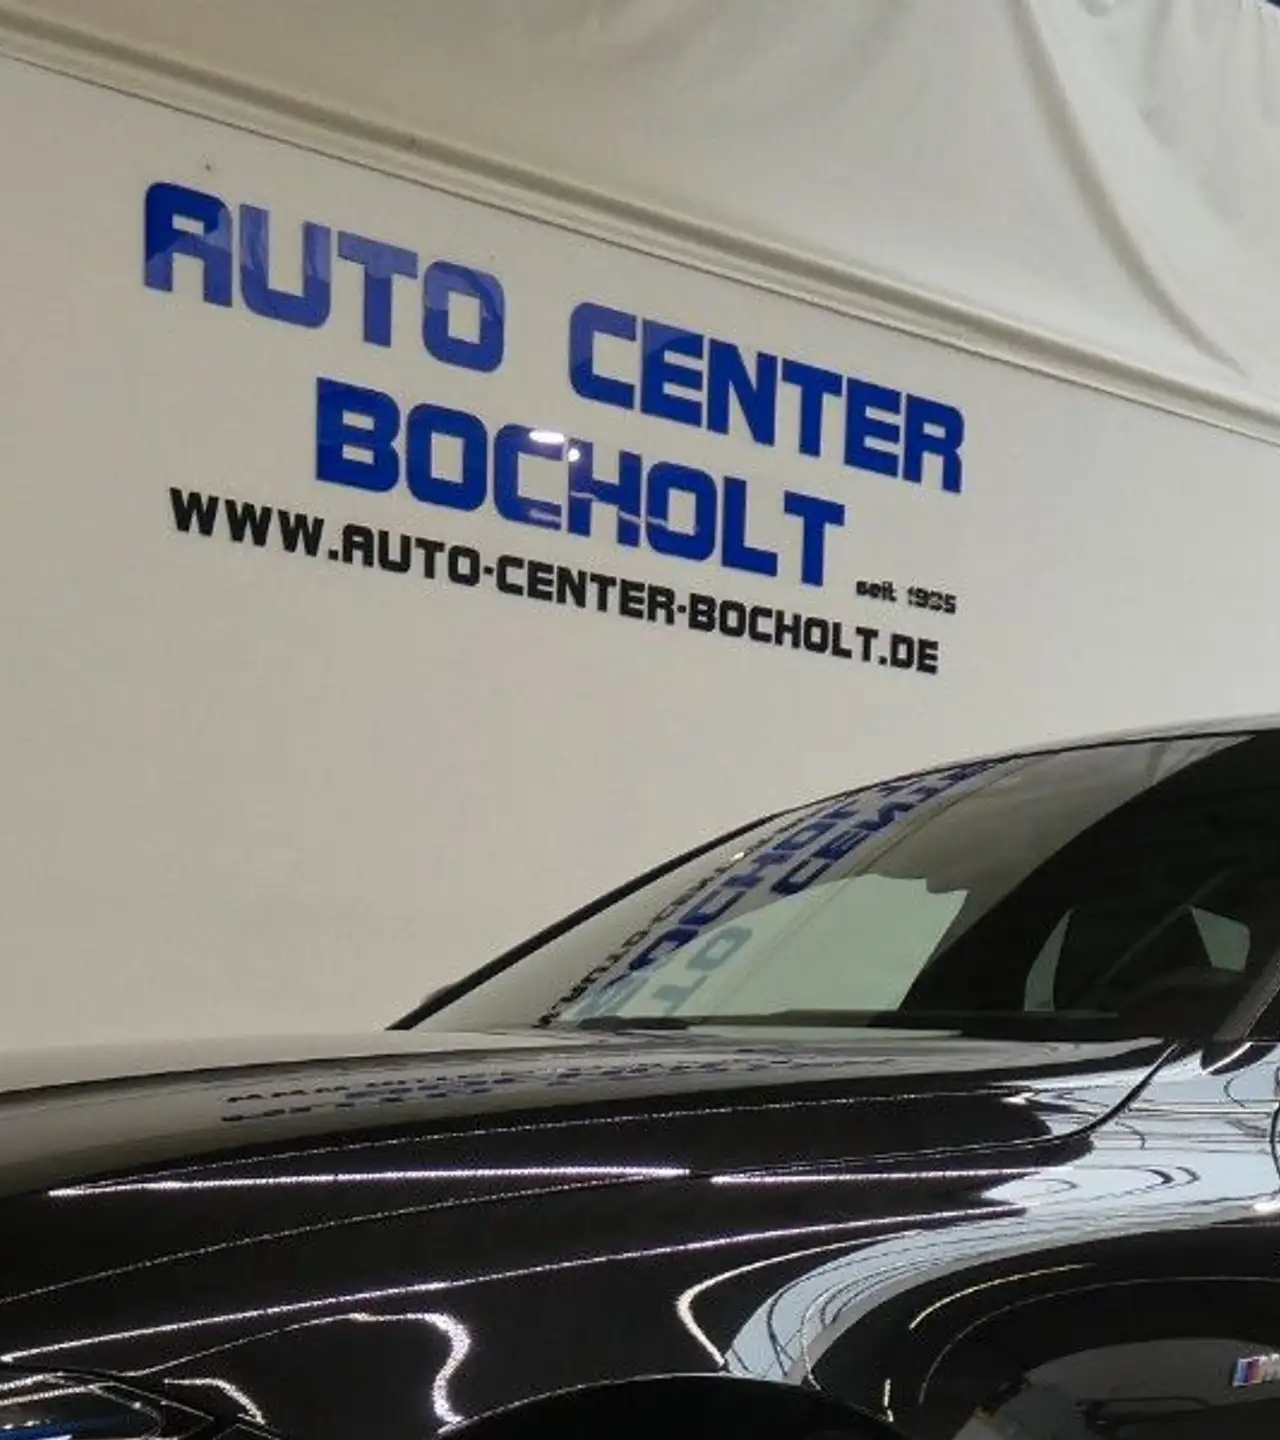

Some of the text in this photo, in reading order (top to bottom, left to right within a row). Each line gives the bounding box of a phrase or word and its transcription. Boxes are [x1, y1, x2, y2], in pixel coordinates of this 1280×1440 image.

[144, 182, 966, 495] AUTO CENTER
[169, 487, 940, 676] WWW.AUTO-CENTER-BOCHOLT.DE
[314, 377, 847, 588] BOCHOLT
